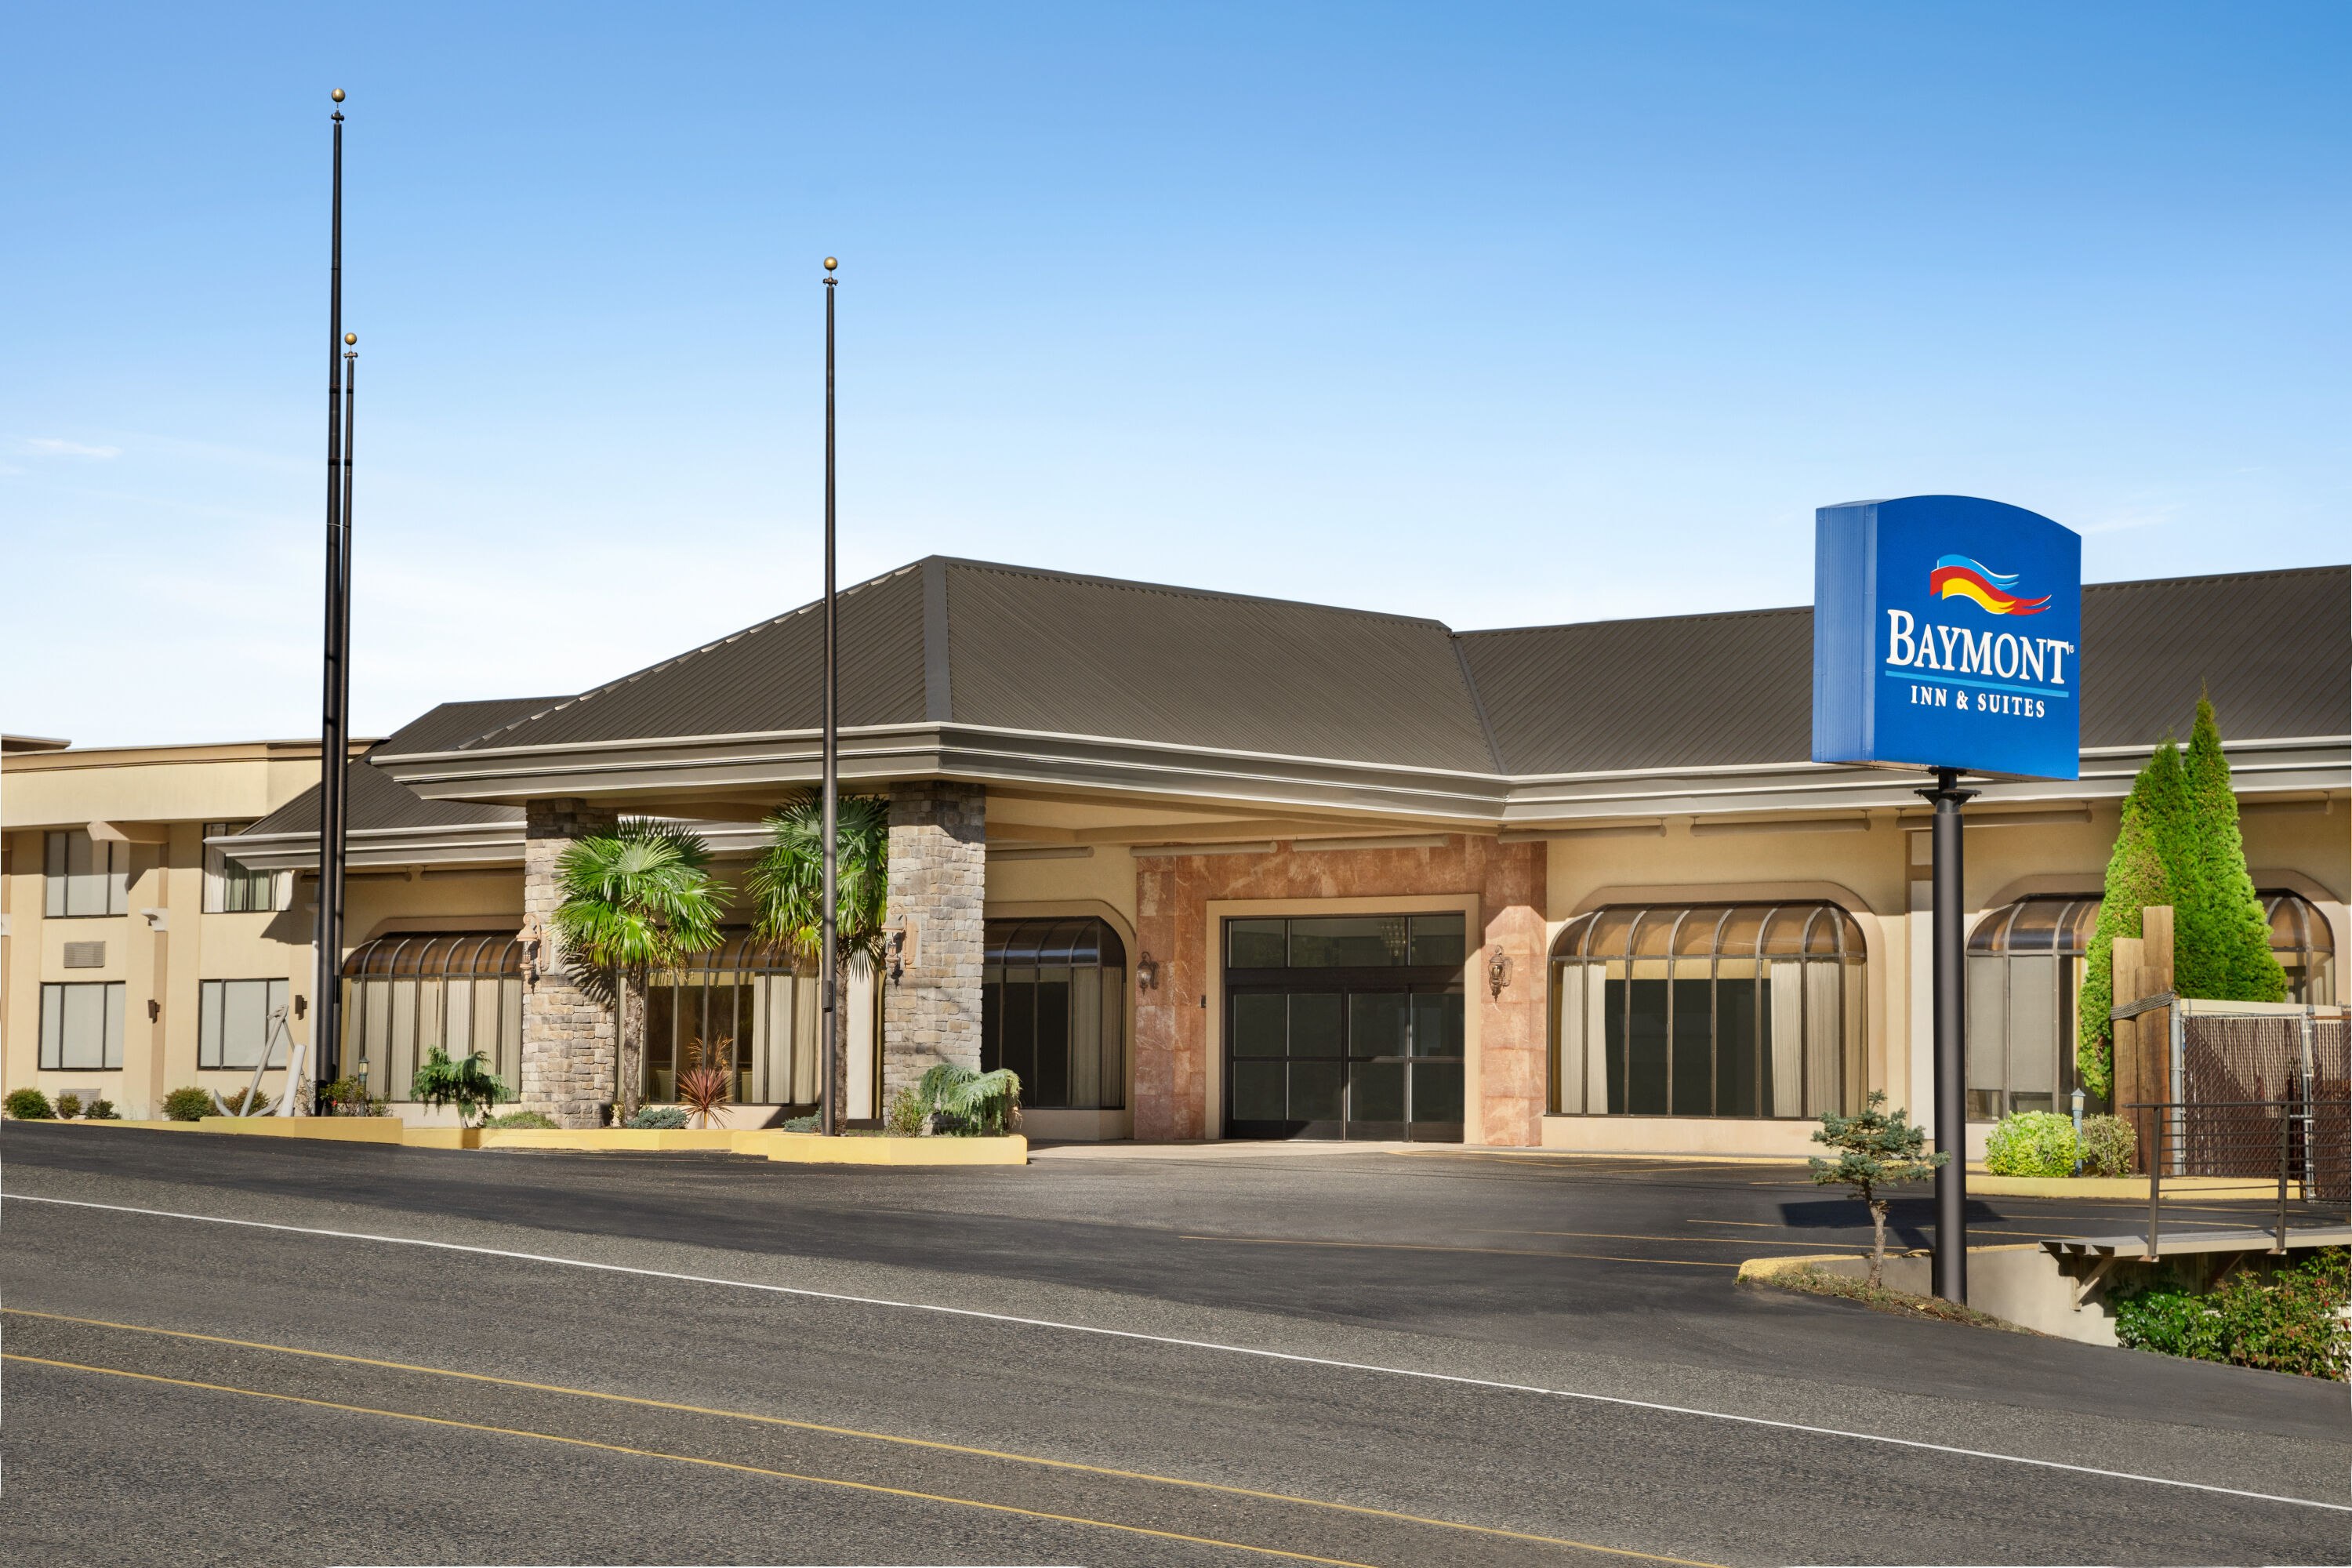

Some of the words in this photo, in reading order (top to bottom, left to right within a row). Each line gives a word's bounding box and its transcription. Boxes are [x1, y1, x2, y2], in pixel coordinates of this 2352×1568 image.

[1886, 608, 2071, 684] BAYMONT
[1911, 685, 1947, 707] INN
[1956, 690, 1969, 710] &
[1977, 693, 2045, 718] SUITES
